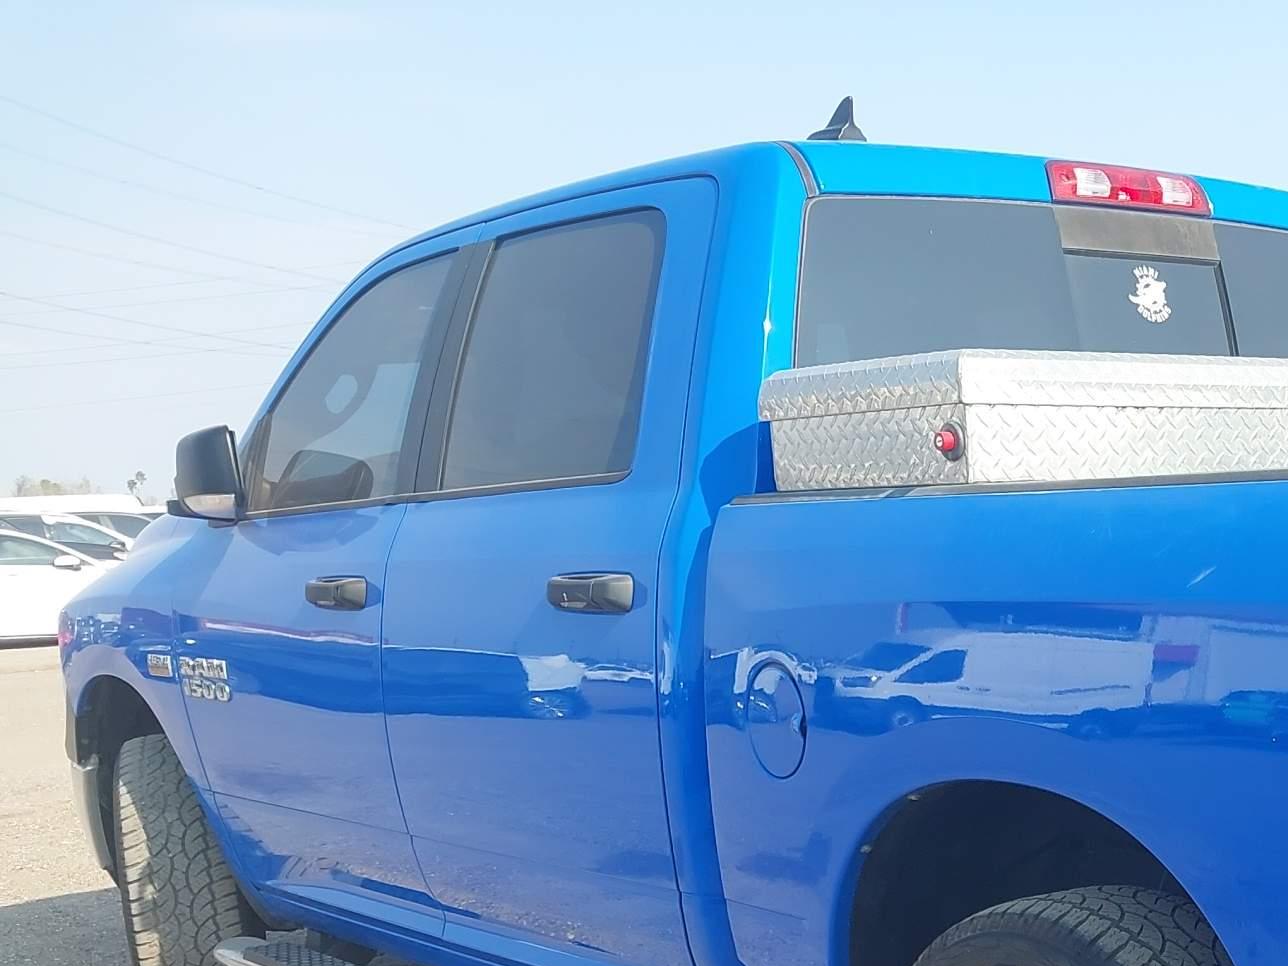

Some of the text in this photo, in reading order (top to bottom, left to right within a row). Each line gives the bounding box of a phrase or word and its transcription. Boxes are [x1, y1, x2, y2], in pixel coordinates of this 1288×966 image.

[1133, 265, 1159, 280] MIAMI
[179, 656, 228, 680] RAM
[182, 678, 231, 702] 1500
